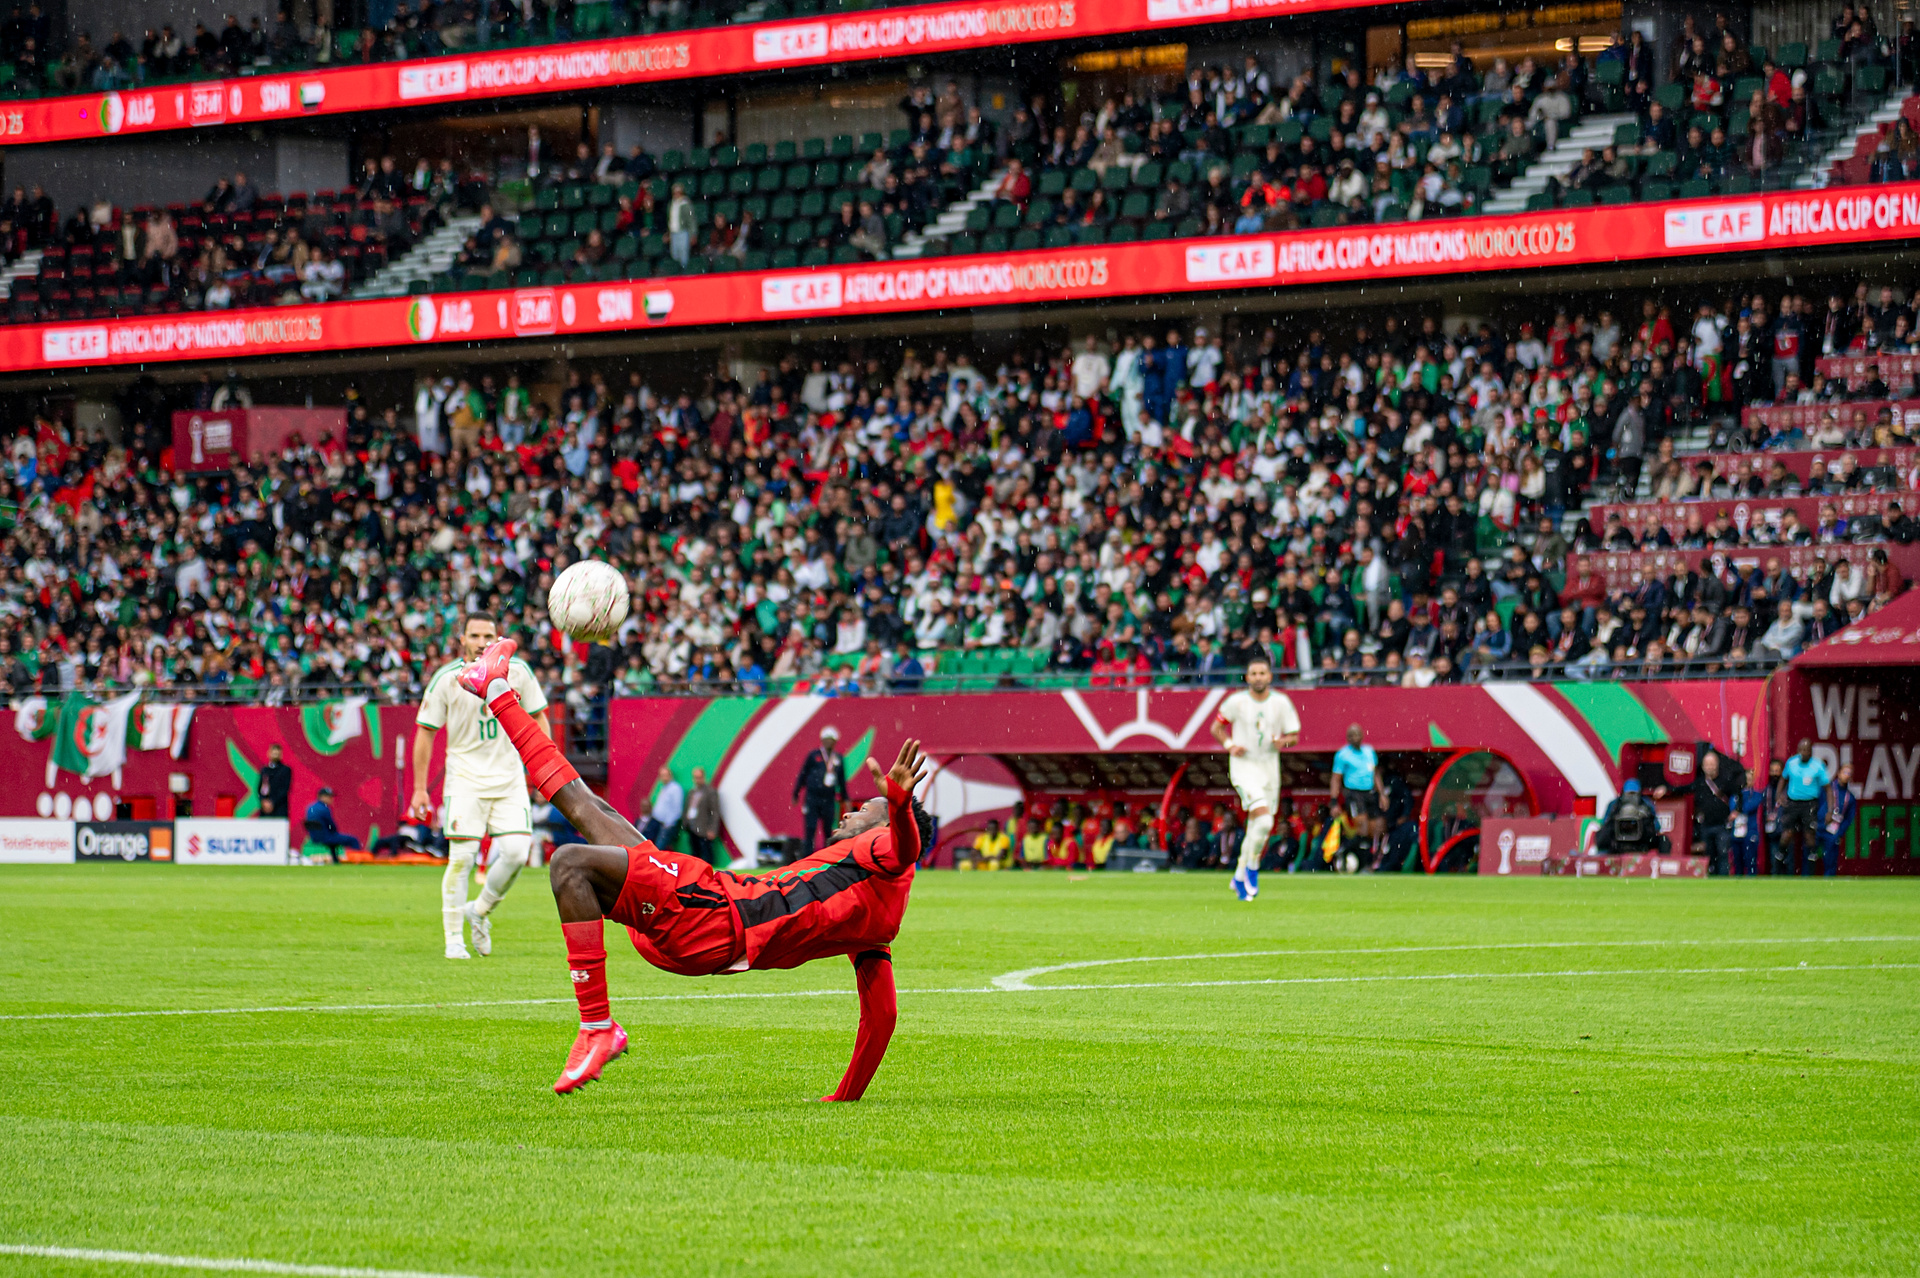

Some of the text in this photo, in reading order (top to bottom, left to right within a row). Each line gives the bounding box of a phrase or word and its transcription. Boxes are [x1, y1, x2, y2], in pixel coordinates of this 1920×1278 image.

[830, 21, 877, 51] AFRICA
[877, 17, 905, 47] CUP
[926, 8, 987, 41] NATIONS
[470, 61, 511, 88] AFRICA
[127, 93, 156, 125] ALG
[229, 84, 242, 115] 0
[1702, 211, 1751, 238] CAF
[1768, 199, 1835, 236] AFRICA
[1835, 195, 1873, 231] CUP
[1873, 193, 1900, 229] OF
[1219, 222, 1576, 273] CAF AFRICA CUP OF NATIONS MOROCCO 25
[791, 281, 831, 304] CAF
[844, 272, 895, 303] AFRICA
[895, 269, 925, 300] CUP
[925, 267, 946, 298] OF
[947, 262, 1012, 296] NATIONS
[1011, 259, 1089, 291] MOROCCO
[440, 299, 474, 333] ALG
[498, 298, 508, 329] 1
[562, 291, 576, 326] 0
[598, 289, 633, 323] SDN
[110, 327, 150, 354] AFRICA
[479, 718, 497, 740] 10
[1810, 683, 1881, 740] WE
[77, 827, 148, 861] Orange
[207, 834, 276, 854] SUZUKI
